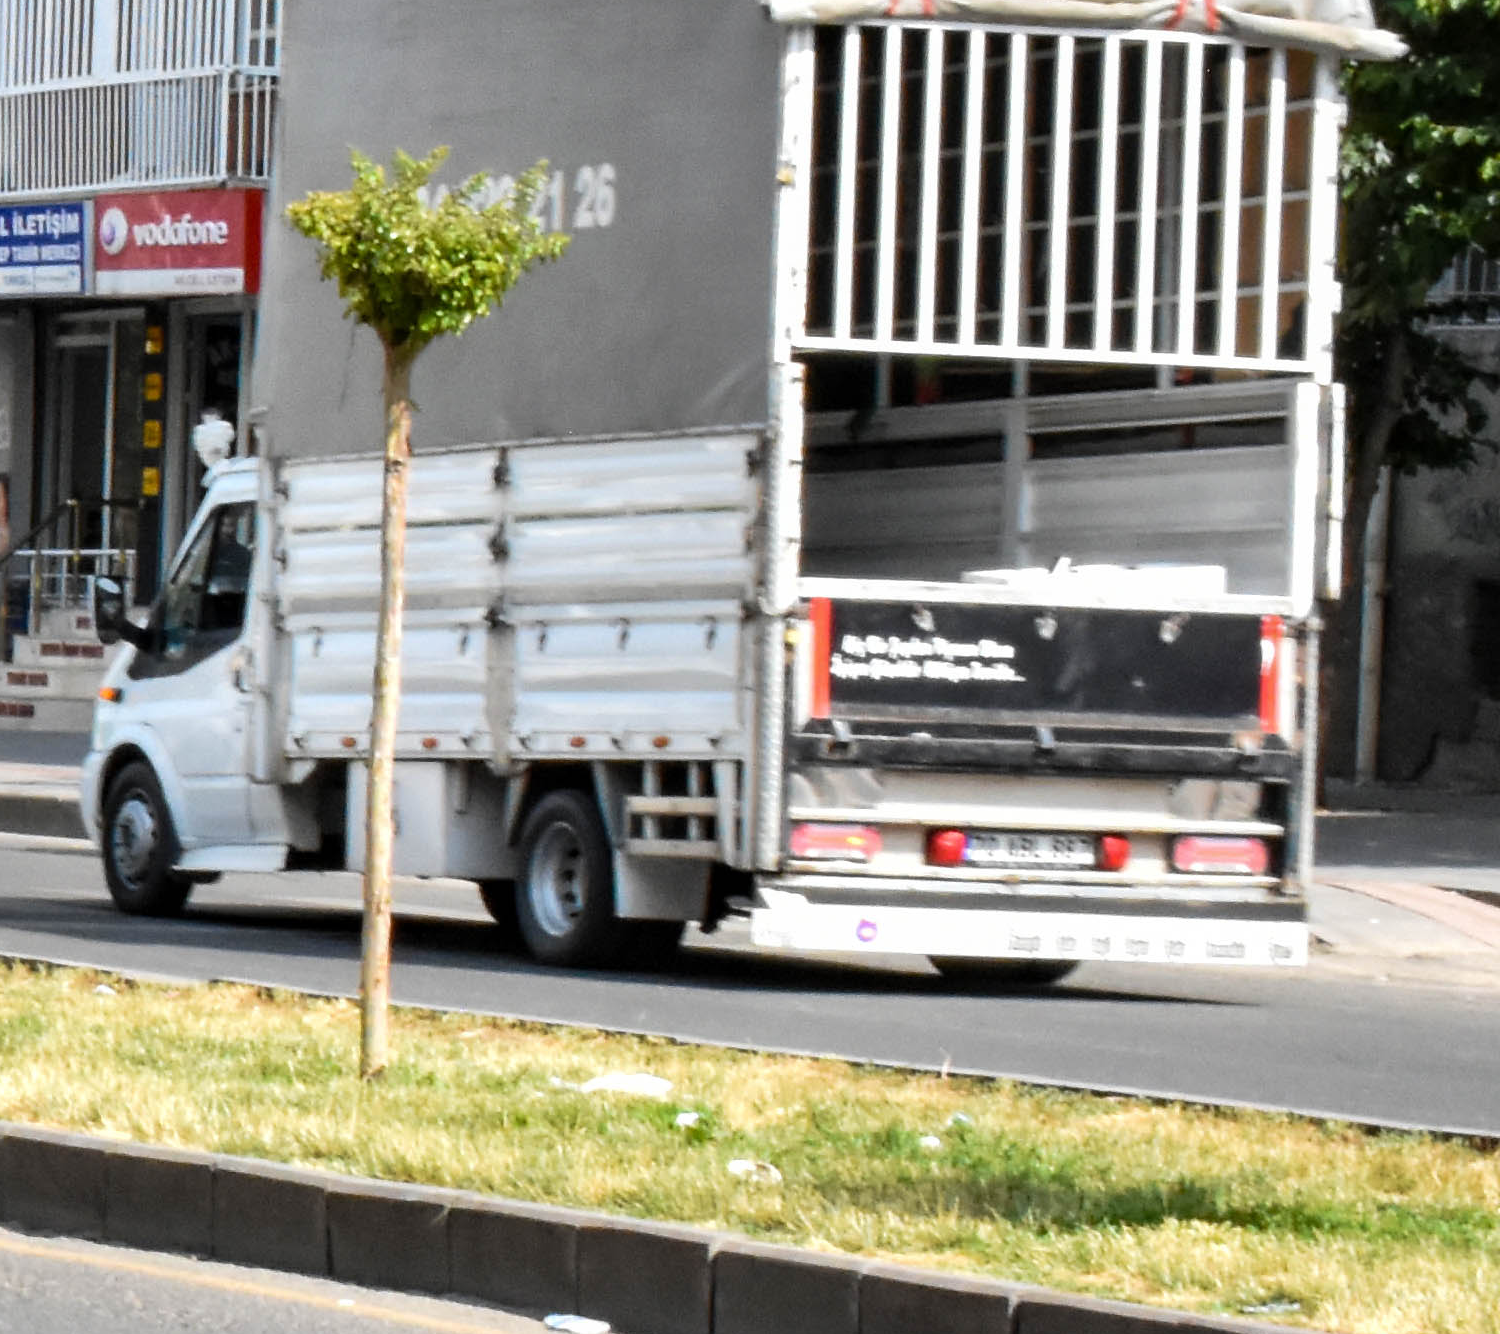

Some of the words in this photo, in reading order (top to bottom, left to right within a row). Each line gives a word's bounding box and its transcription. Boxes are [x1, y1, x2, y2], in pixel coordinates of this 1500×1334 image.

[572, 163, 617, 228] 26
[12, 208, 80, 240] İLETİŞİM
[132, 213, 229, 246] vodafone
